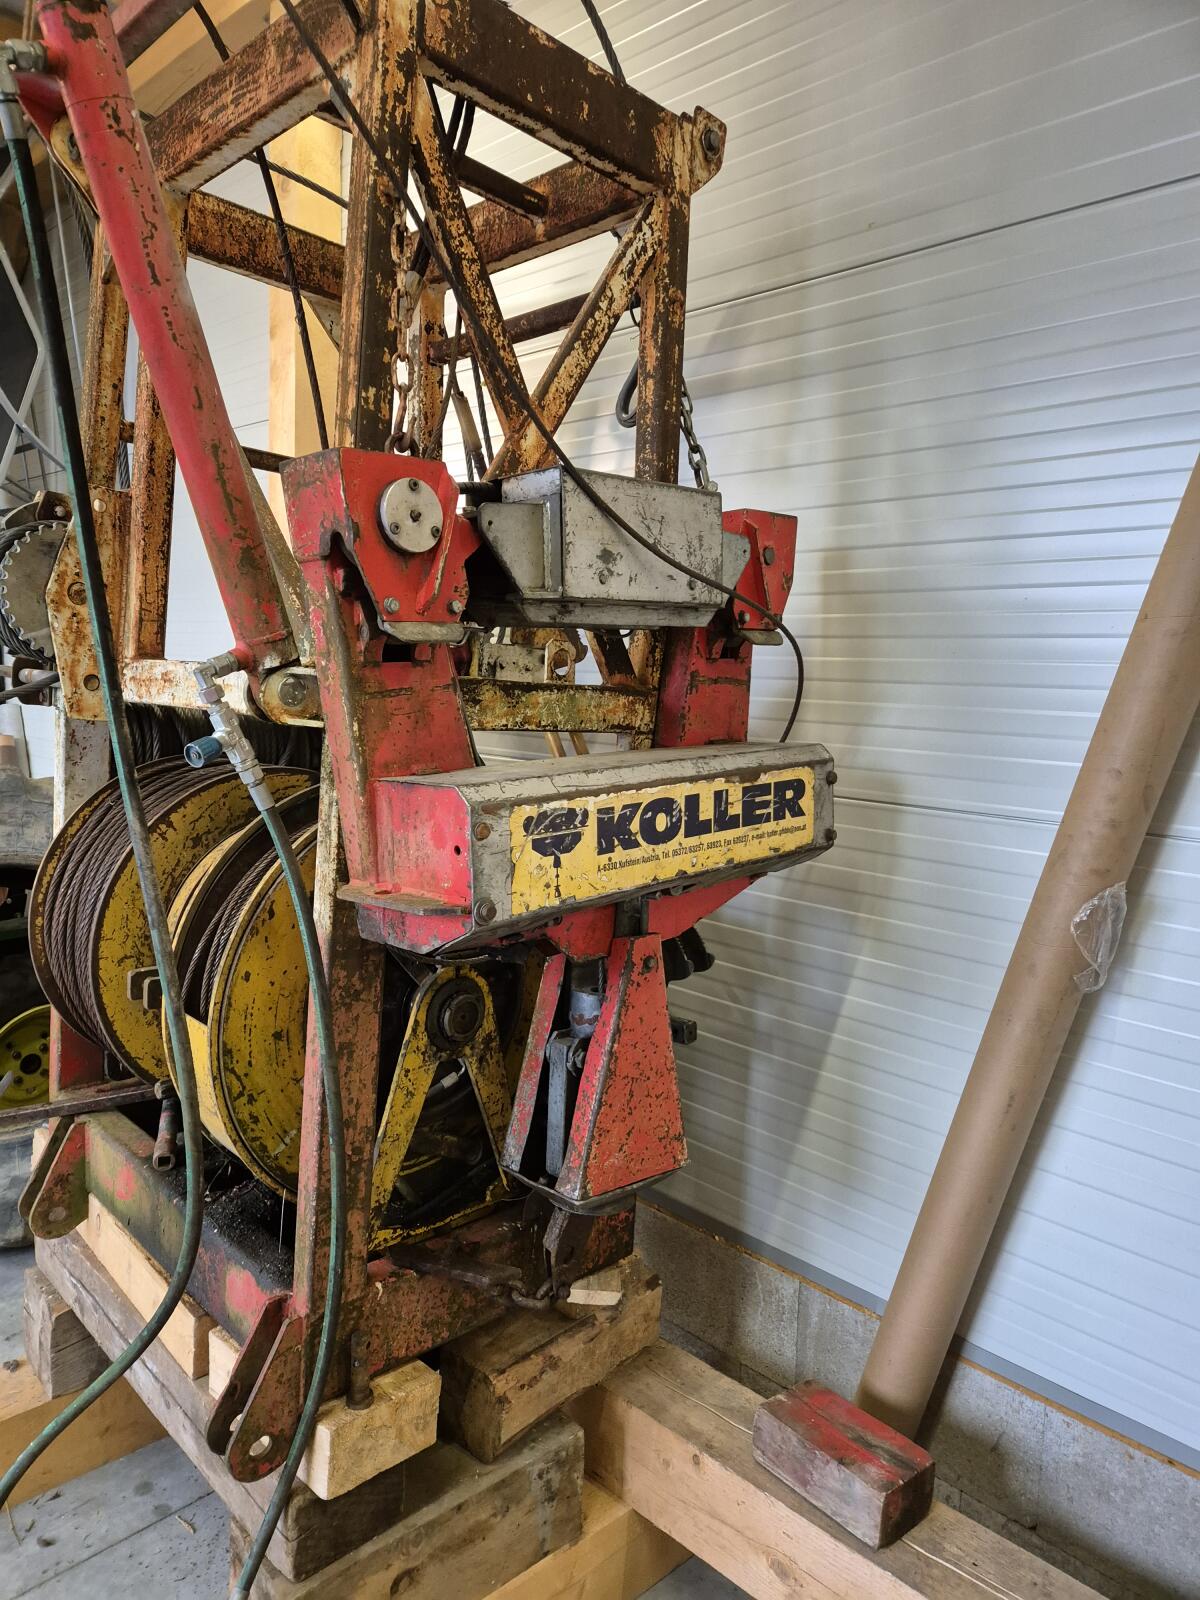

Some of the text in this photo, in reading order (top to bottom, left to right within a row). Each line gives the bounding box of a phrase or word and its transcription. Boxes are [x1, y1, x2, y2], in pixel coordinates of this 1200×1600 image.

[597, 778, 806, 856] KOLLER
[662, 851, 671, 860] Tel.
[724, 838, 732, 847] Fax
